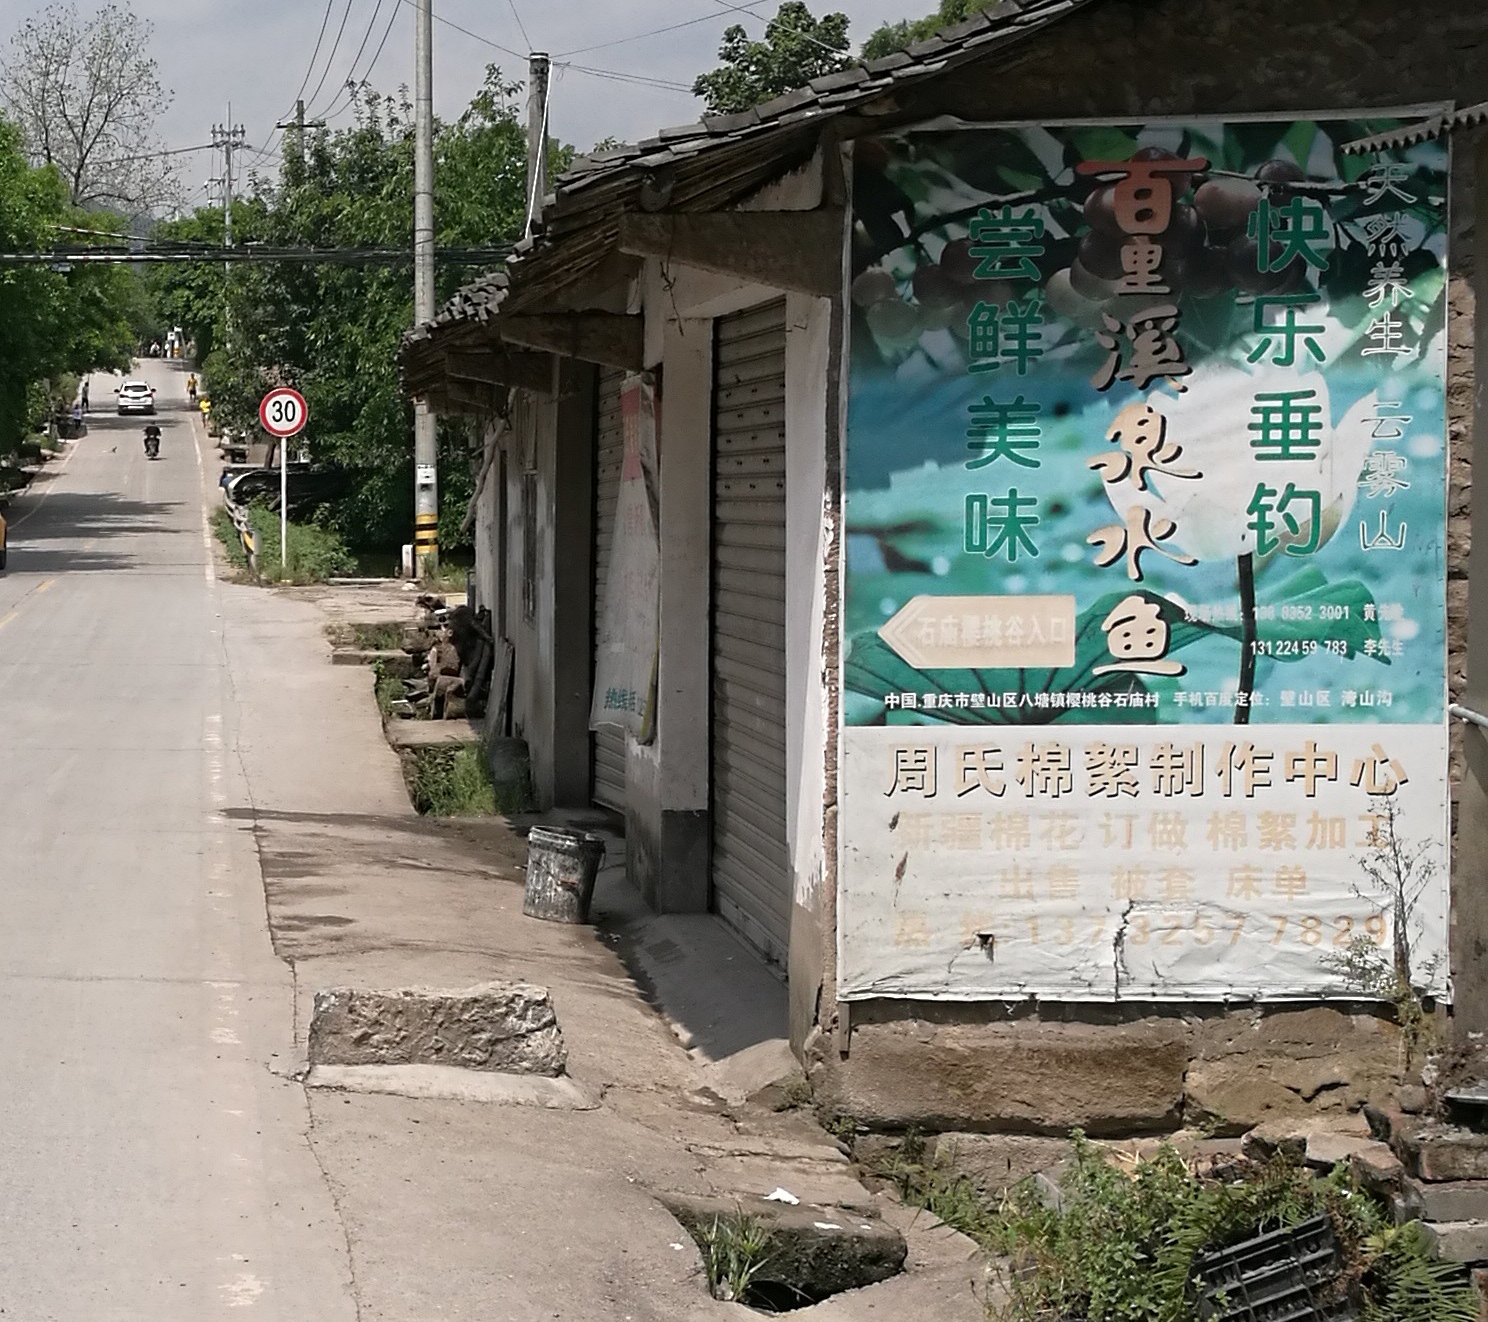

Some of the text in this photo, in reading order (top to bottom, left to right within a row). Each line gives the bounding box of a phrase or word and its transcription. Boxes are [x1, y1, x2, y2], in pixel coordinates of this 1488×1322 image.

[1360, 162, 1417, 358] 天然养生
[963, 204, 1047, 564] 尝鲜美味
[1245, 195, 1330, 559] 快乐垂钓
[272, 400, 296, 423] 30
[1074, 157, 1212, 677] 百里溪泉水鱼
[1357, 399, 1413, 552] 云雾山
[916, 613, 1067, 647] 石庙樱桃谷入口
[1319, 605, 1350, 620] 3001
[1324, 640, 1348, 655] 783
[1363, 639, 1404, 656] 李先生
[883, 740, 1409, 798] 周氏棉絮制作中心
[1099, 811, 1189, 850] 订做
[1206, 810, 1391, 851] 棉絮加工
[1111, 864, 1195, 902] 被套
[1225, 864, 1307, 902] 床单
